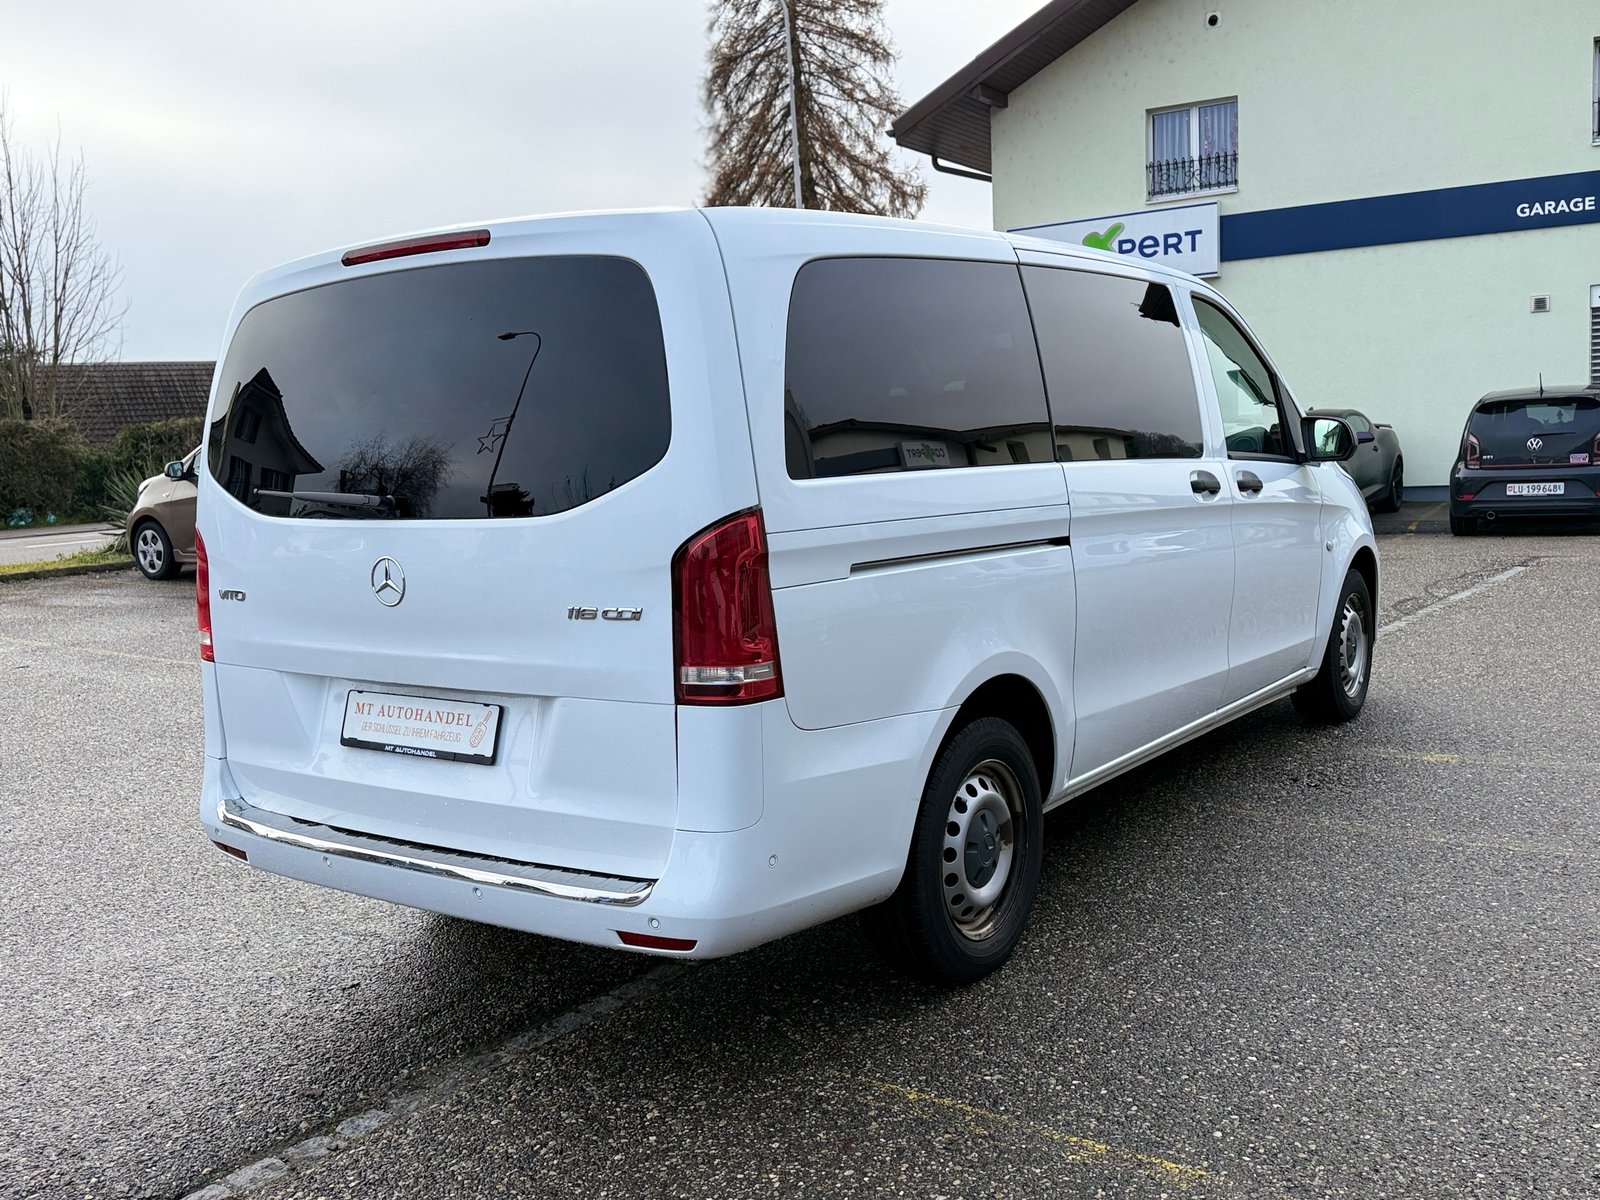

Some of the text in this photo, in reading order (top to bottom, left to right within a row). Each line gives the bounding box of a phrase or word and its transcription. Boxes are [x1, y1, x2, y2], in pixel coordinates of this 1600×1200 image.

[1516, 196, 1596, 218] GARAGE
[218, 588, 247, 602] VITO
[567, 606, 643, 621] 116 CDI
[354, 702, 473, 727] MT AUTOHANDEL
[361, 721, 373, 731] DER
[403, 726, 412, 736] ZU
[412, 727, 430, 739] IHREM
[430, 729, 461, 742] FAHRZEUG
[395, 746, 437, 758] AUTOHANDEL
